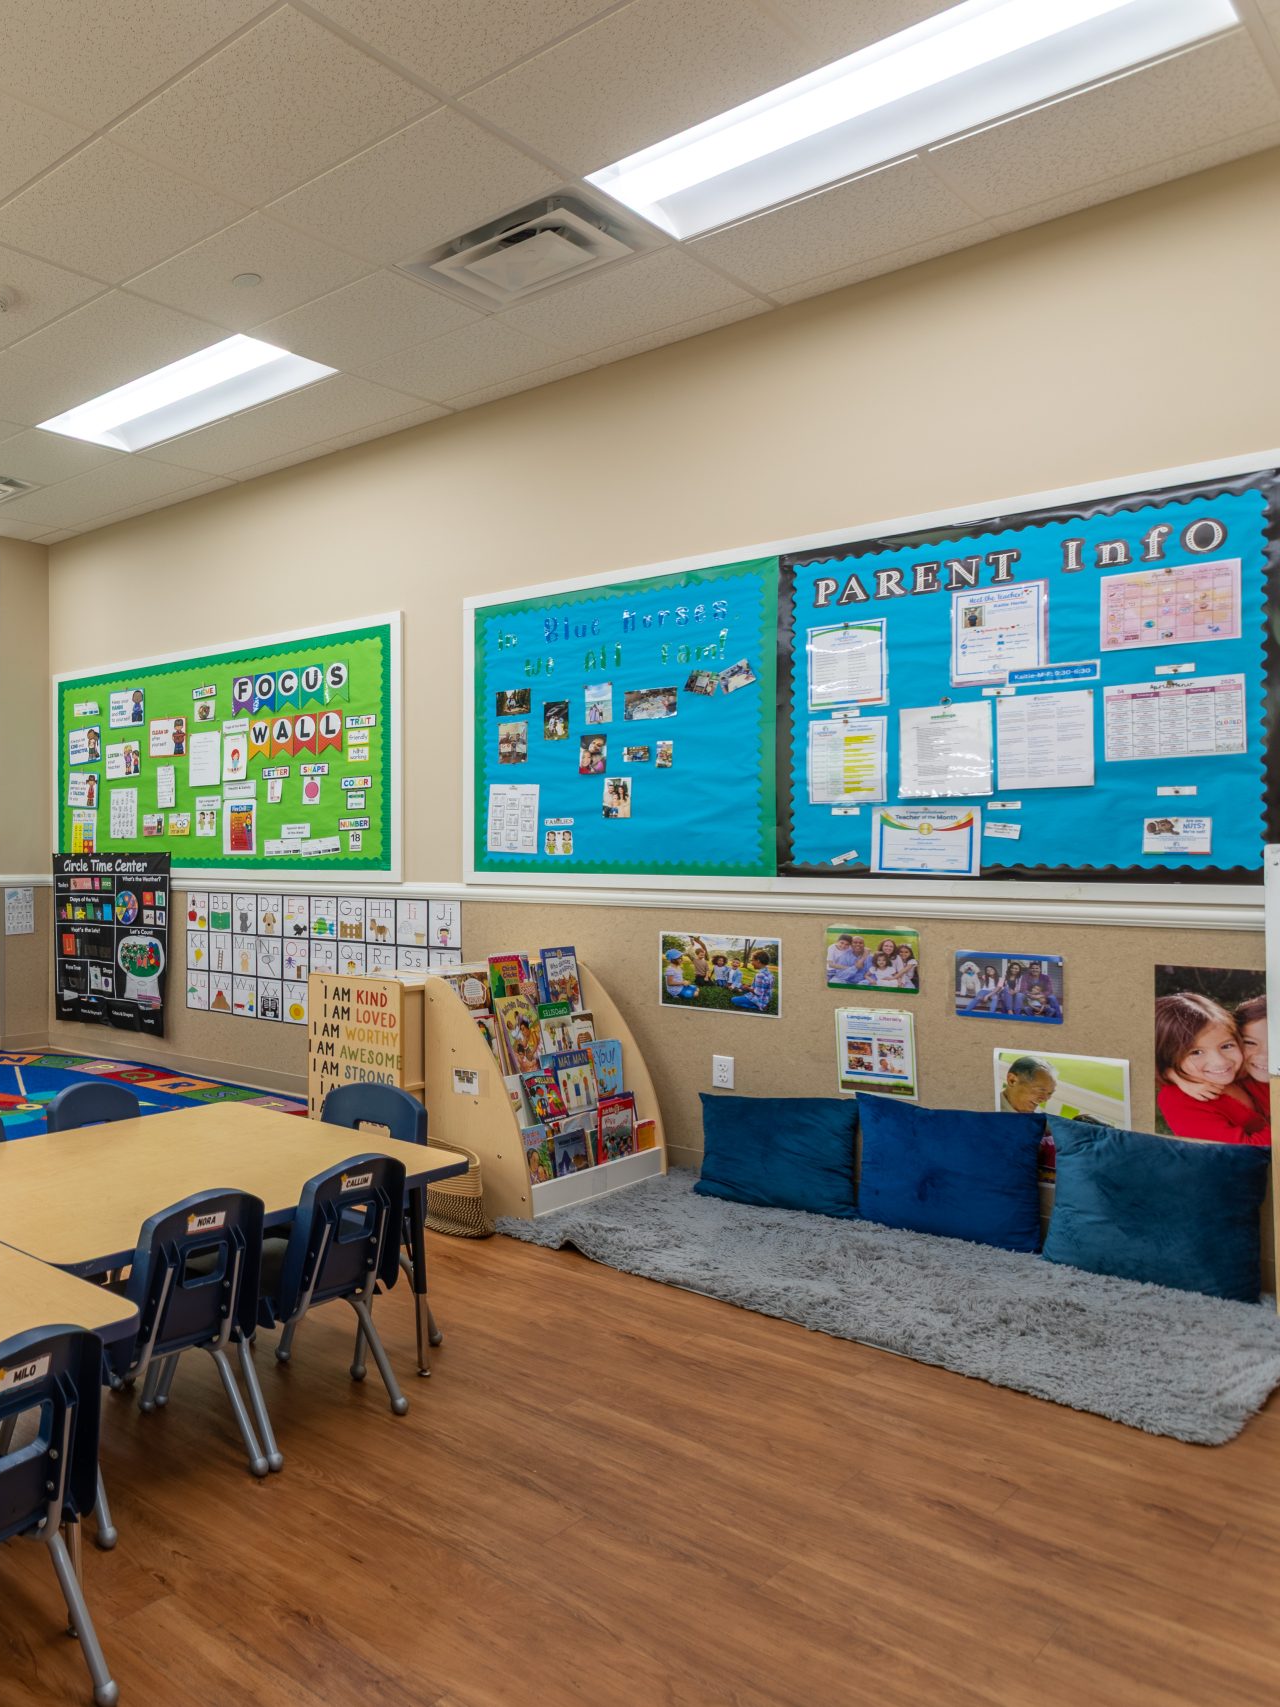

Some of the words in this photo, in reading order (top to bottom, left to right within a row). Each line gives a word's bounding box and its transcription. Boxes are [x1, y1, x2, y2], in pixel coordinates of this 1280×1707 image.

[814, 550, 1019, 607] PARENT
[544, 617, 600, 643] Blue
[238, 666, 343, 700] FOCUS
[195, 687, 214, 697] THEME
[253, 716, 336, 743] WALL
[350, 717, 371, 726] TRAIT
[263, 768, 288, 777] LETTER
[303, 765, 325, 773] SHAPE
[343, 778, 369, 787] COLOR
[340, 820, 368, 828] NUMBER
[350, 833, 360, 842] 18
[64, 859, 89, 872] Circle
[90, 859, 113, 872] Time
[115, 858, 147, 873] Center
[212, 895, 228, 910] Bb
[235, 896, 253, 912] Cc
[260, 897, 279, 912] Dd
[287, 898, 305, 914] Ee
[314, 899, 333, 915] Ff
[340, 900, 362, 921] Gg
[370, 901, 392, 918] Hh
[436, 903, 452, 926] Jj
[190, 934, 206, 948] Kk
[234, 936, 256, 950] Mm
[260, 940, 280, 955] Nn
[286, 941, 306, 957] Oo
[314, 943, 333, 964] Pp
[341, 944, 363, 966] Qq
[373, 948, 391, 965] Rr
[404, 950, 421, 968] Ss
[190, 973, 206, 987] Uu
[213, 975, 230, 990] Vv
[234, 977, 255, 992] Ww
[262, 981, 278, 997] Xx
[286, 984, 305, 1003] Yy
[324, 985, 327, 999] I
[332, 986, 351, 1003] AM
[356, 989, 388, 1008] KIND
[324, 1003, 327, 1018] I
[332, 1005, 351, 1021] AM
[356, 1008, 397, 1028] LOVED
[313, 1021, 317, 1035] I
[322, 1022, 340, 1038] AM
[345, 1026, 399, 1048] WORTHY
[308, 1039, 312, 1052] I
[317, 1040, 335, 1056] AM
[339, 1045, 403, 1071] AWESOME
[558, 1055, 571, 1065] MAT
[596, 1047, 615, 1064] YOU!
[313, 1058, 316, 1072] I
[321, 1060, 339, 1077] AM
[344, 1065, 394, 1086] STRONG
[320, 1081, 324, 1095] I
[345, 1176, 370, 1188] CALLUM
[196, 1216, 217, 1227] NORA
[13, 1364, 37, 1383] MILO
